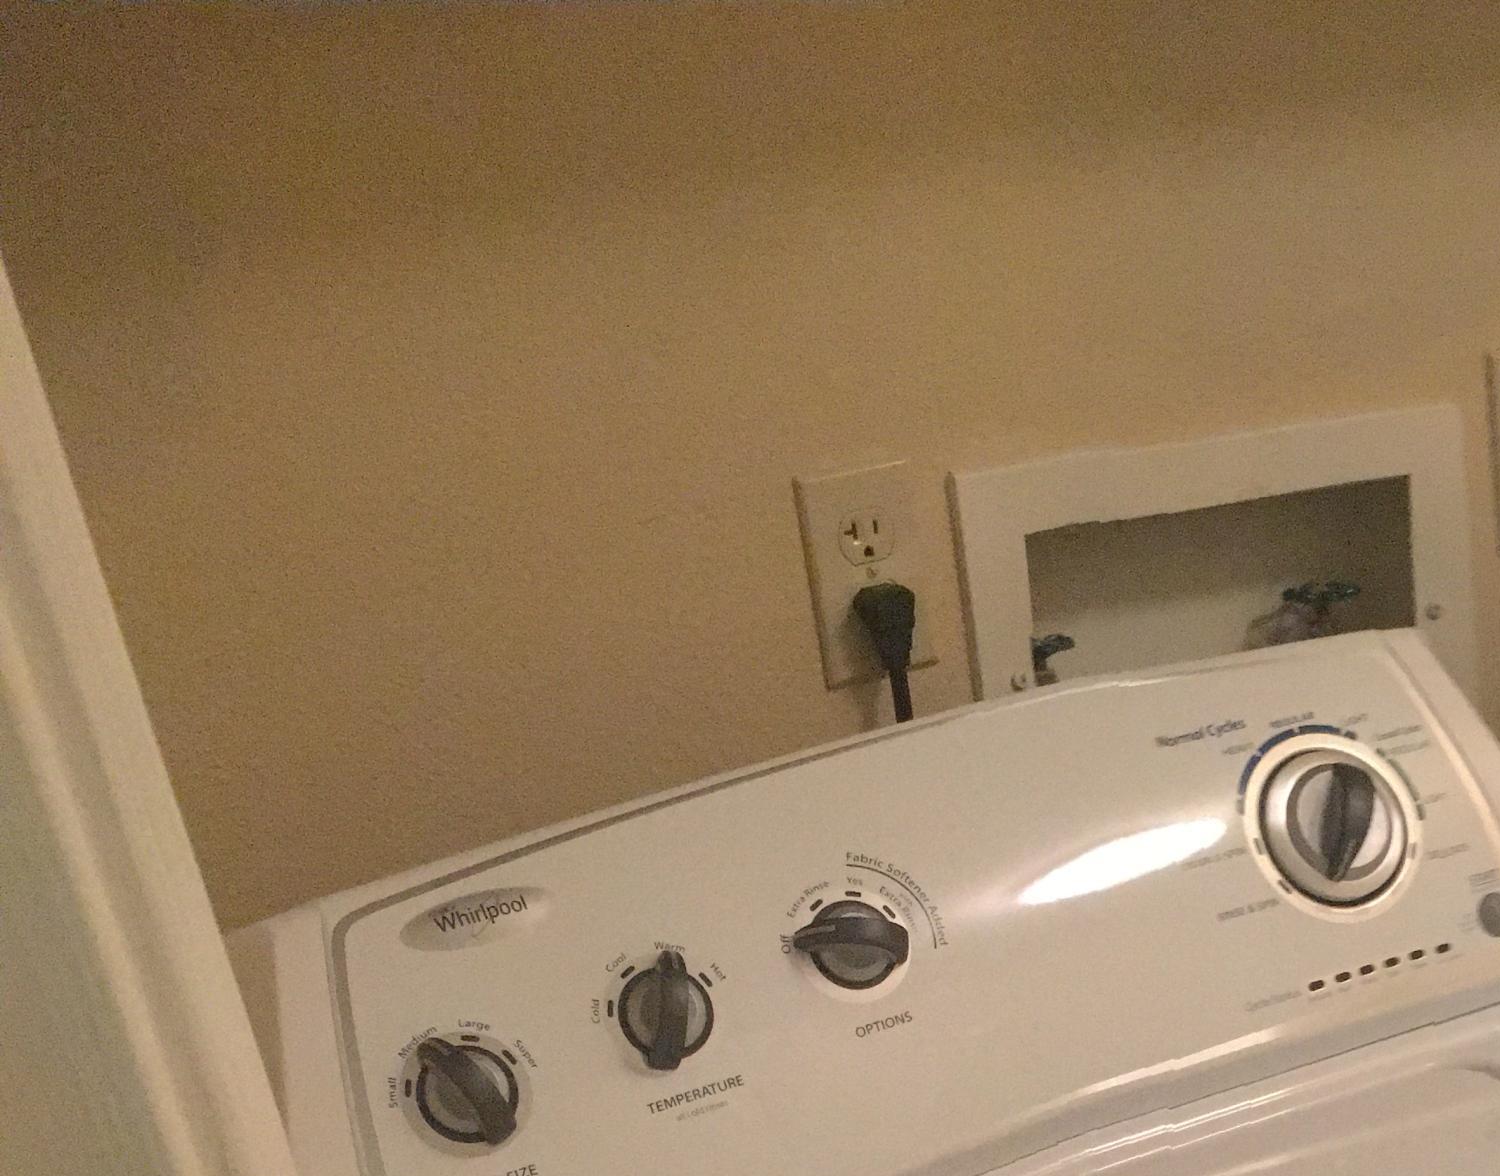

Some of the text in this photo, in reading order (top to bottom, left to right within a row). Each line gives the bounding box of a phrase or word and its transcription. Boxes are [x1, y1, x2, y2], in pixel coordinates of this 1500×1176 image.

[846, 876, 864, 887] Yes
[787, 880, 830, 918] Extra Rinse
[846, 852, 949, 947] Fabric Softener Added
[432, 894, 529, 934] Whirlpool
[653, 941, 686, 953] Warm
[780, 933, 792, 954] Off
[605, 952, 628, 974] Cool
[709, 962, 728, 982] Hot
[458, 1018, 491, 1032] Large
[591, 998, 600, 1024] Cold
[855, 1011, 913, 1039] OPTIONS
[397, 1025, 438, 1060] Medium
[513, 1039, 539, 1070] Super
[387, 1077, 399, 1109] Small
[646, 1074, 745, 1115] TEMPERATURE
